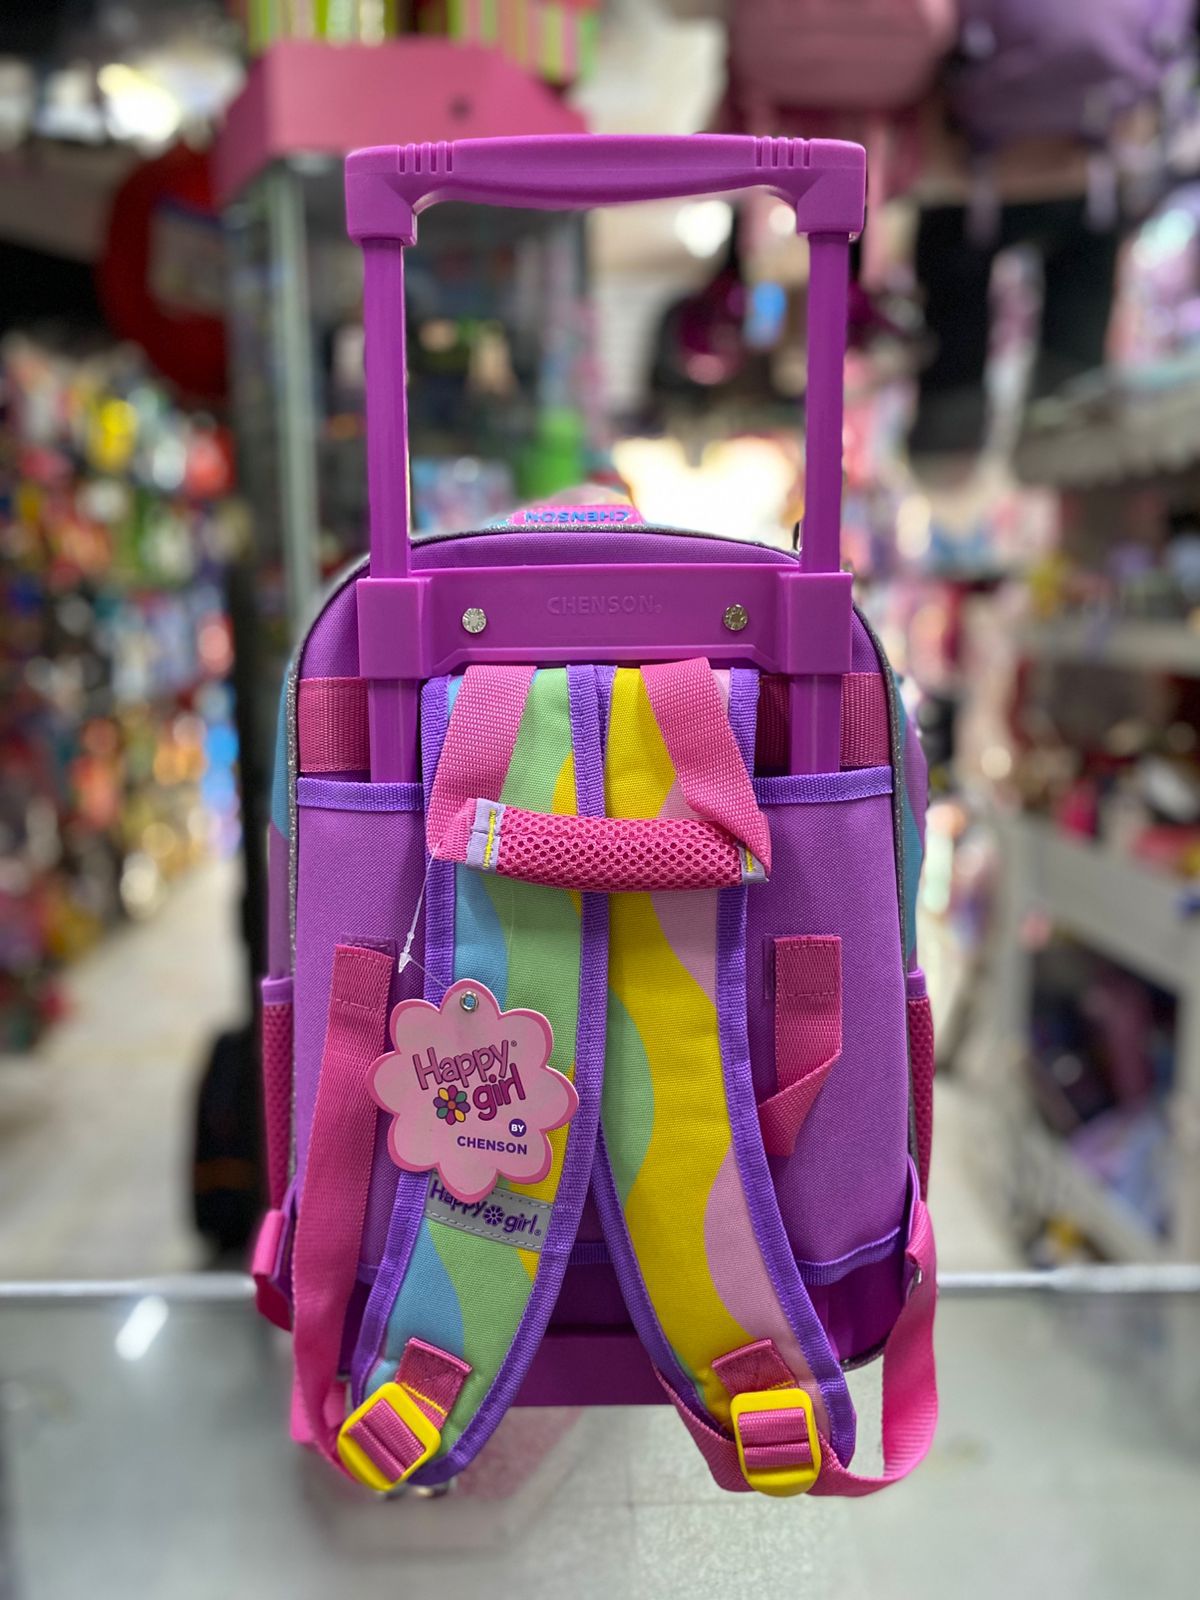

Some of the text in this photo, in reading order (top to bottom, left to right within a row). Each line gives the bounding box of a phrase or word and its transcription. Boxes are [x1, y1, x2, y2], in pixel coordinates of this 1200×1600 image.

[525, 511, 629, 523] CHENSON
[546, 595, 655, 615] CHENSON
[412, 1040, 508, 1090] Happy
[472, 1063, 526, 1120] girl
[510, 1123, 525, 1134] BY
[457, 1136, 528, 1155] CHENSON
[505, 1214, 537, 1234] girl
